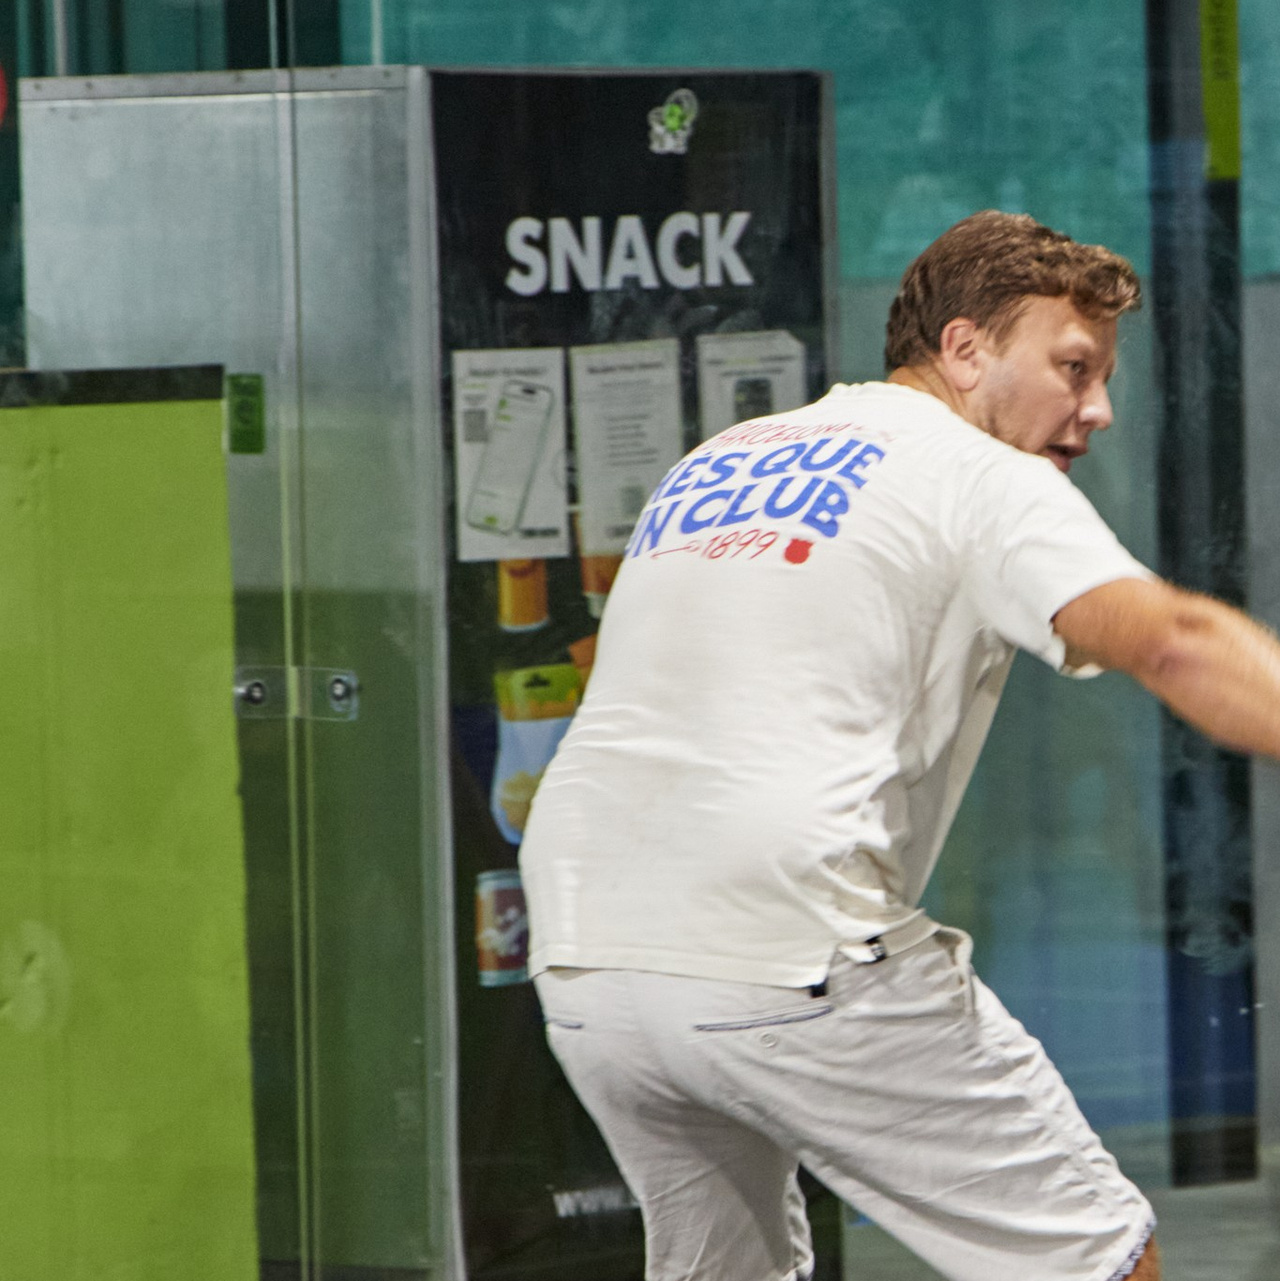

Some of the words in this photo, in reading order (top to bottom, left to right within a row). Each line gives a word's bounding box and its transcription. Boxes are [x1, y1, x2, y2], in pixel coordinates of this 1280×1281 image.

[505, 211, 754, 296] SNACK
[750, 438, 886, 489] QUE
[680, 476, 850, 538] CLUB
[701, 528, 779, 560] 1899
